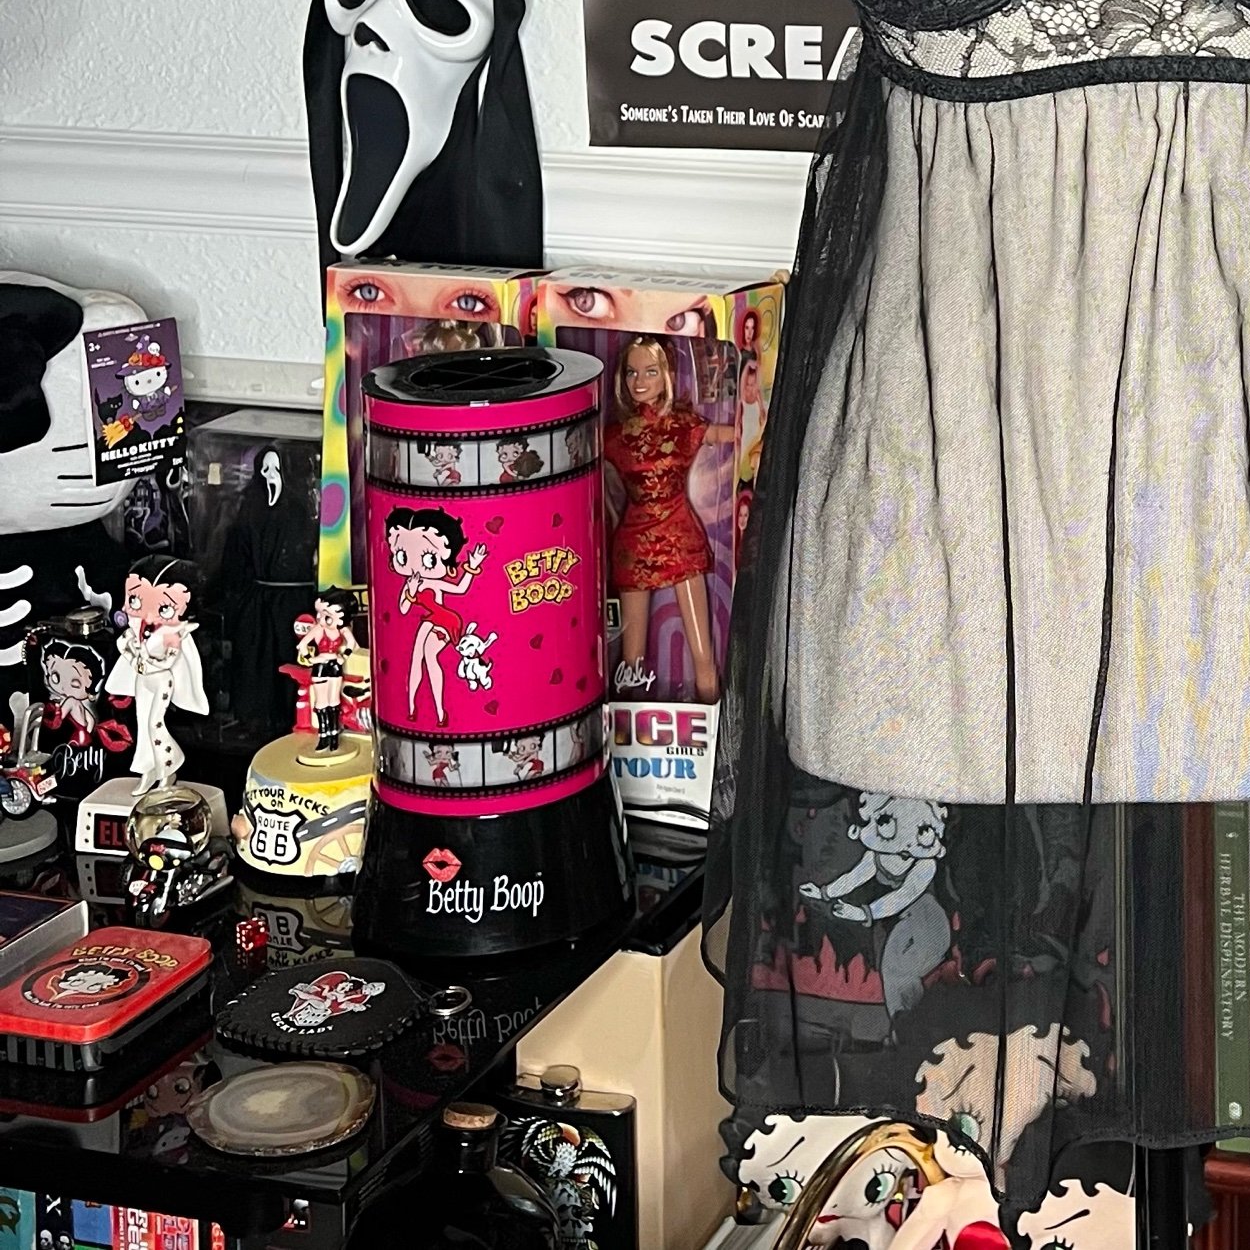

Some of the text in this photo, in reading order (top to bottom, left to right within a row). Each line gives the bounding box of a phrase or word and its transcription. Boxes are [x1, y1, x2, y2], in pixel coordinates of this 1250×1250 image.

[620, 104, 678, 123] SOMEONE'S
[681, 105, 713, 124] TAKEN
[716, 107, 746, 126] THEIR
[750, 108, 776, 127] LOVE
[780, 109, 795, 127] OF
[101, 445, 138, 462] HELLO
[139, 436, 176, 453] KITTY
[504, 547, 581, 587] BETTY
[510, 577, 574, 613] BOOP
[52, 740, 107, 783] Betty
[666, 746, 705, 757] GIRLS
[613, 757, 697, 780] TOUR
[258, 788, 286, 800] YOUR
[289, 793, 330, 817] KICKS
[271, 799, 284, 808] on
[258, 815, 291, 831] ROUTE
[1219, 853, 1232, 918] HERBAL
[426, 875, 545, 923] Betty Boop
[72, 945, 136, 956] BETTY
[136, 949, 180, 968] BOOP
[1233, 893, 1248, 1001] THE MODERN
[271, 1012, 334, 1035] LUCKY LADY
